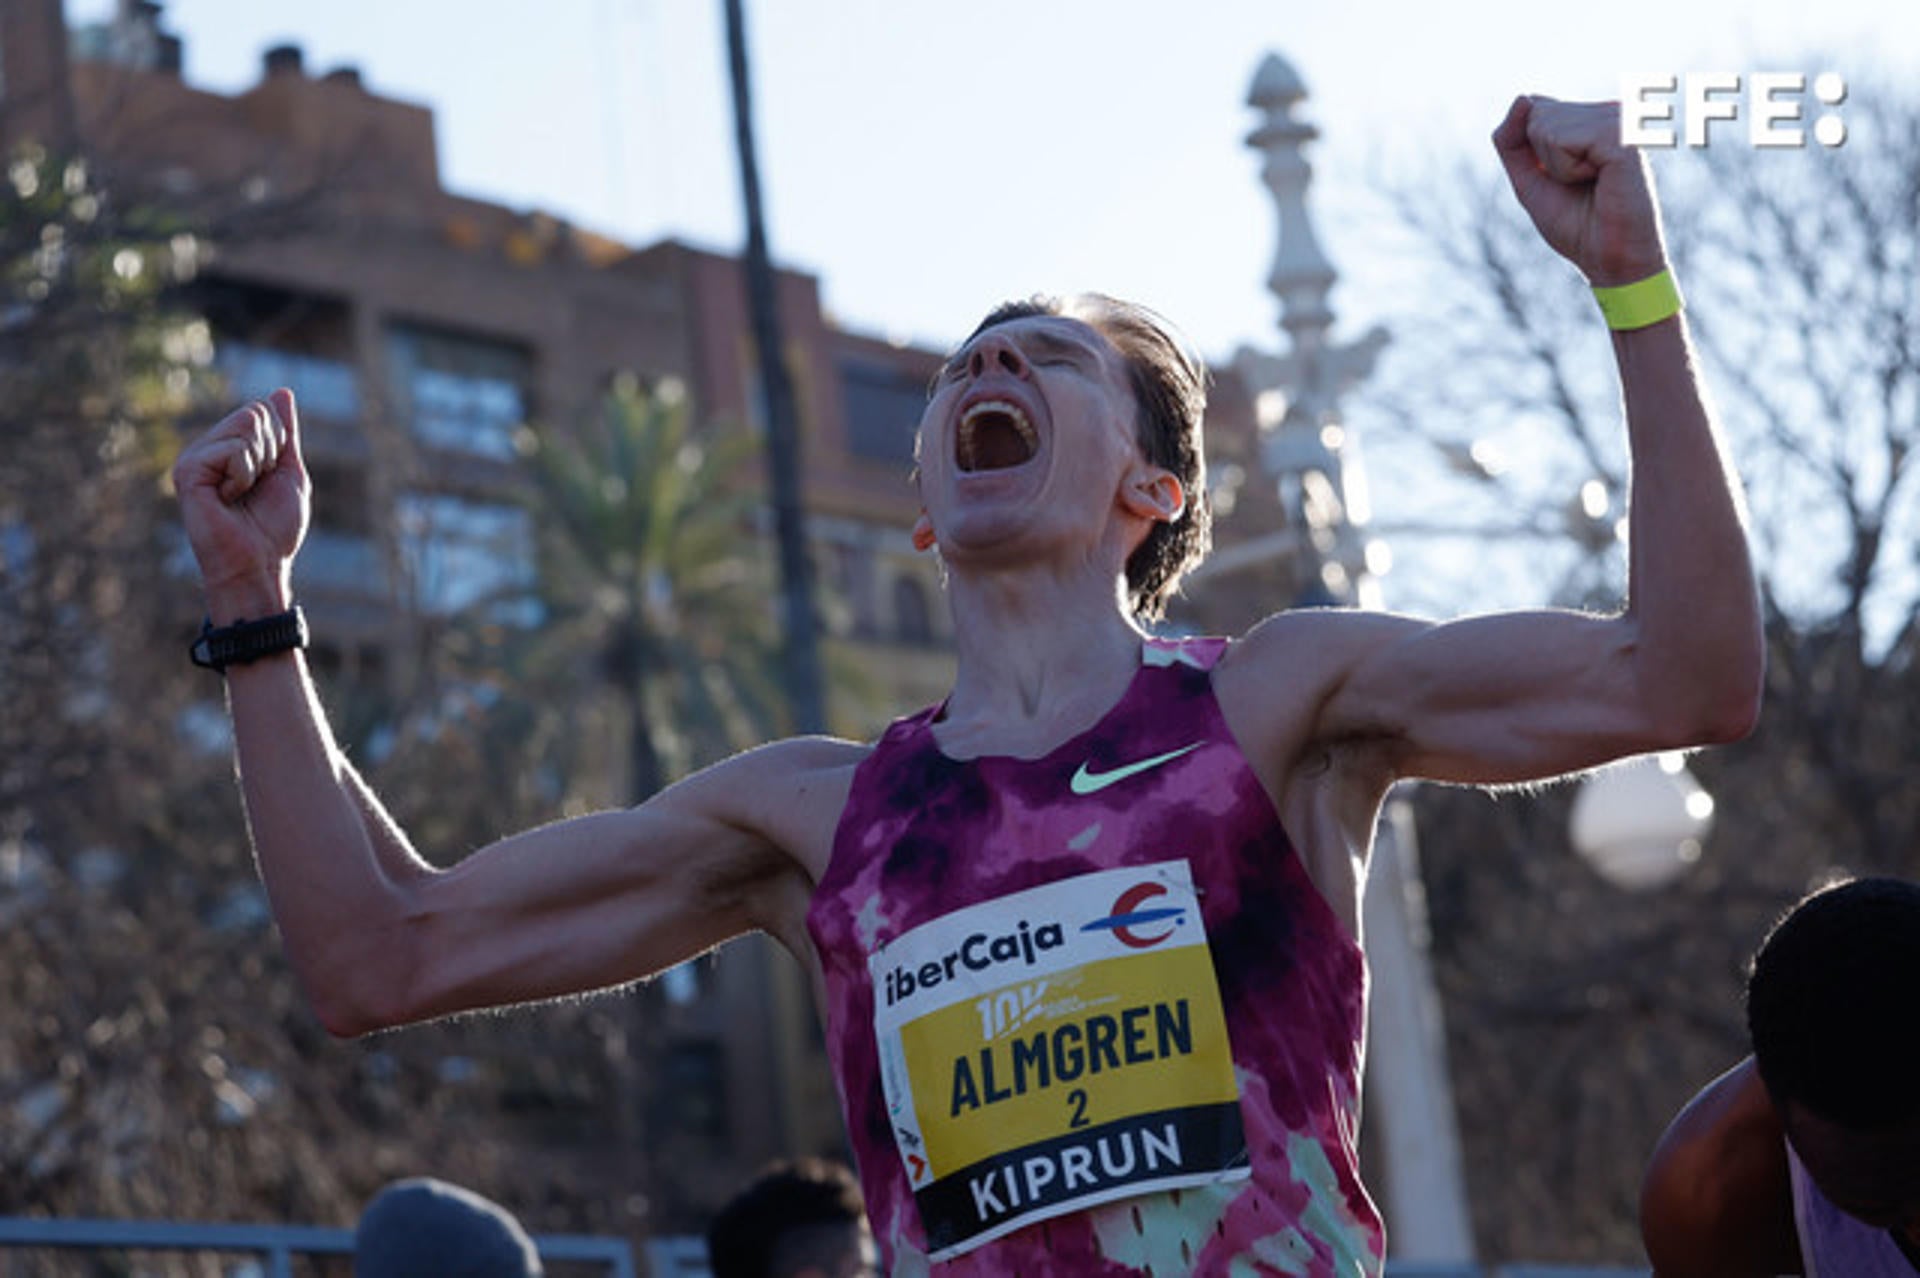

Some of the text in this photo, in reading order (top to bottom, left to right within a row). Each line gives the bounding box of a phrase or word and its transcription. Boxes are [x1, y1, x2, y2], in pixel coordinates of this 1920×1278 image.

[886, 920, 1064, 1006] iberCaja
[950, 1000, 1192, 1118] ALMGREN
[1067, 1089, 1090, 1129] 2
[969, 1124, 1182, 1221] KIPRUN
